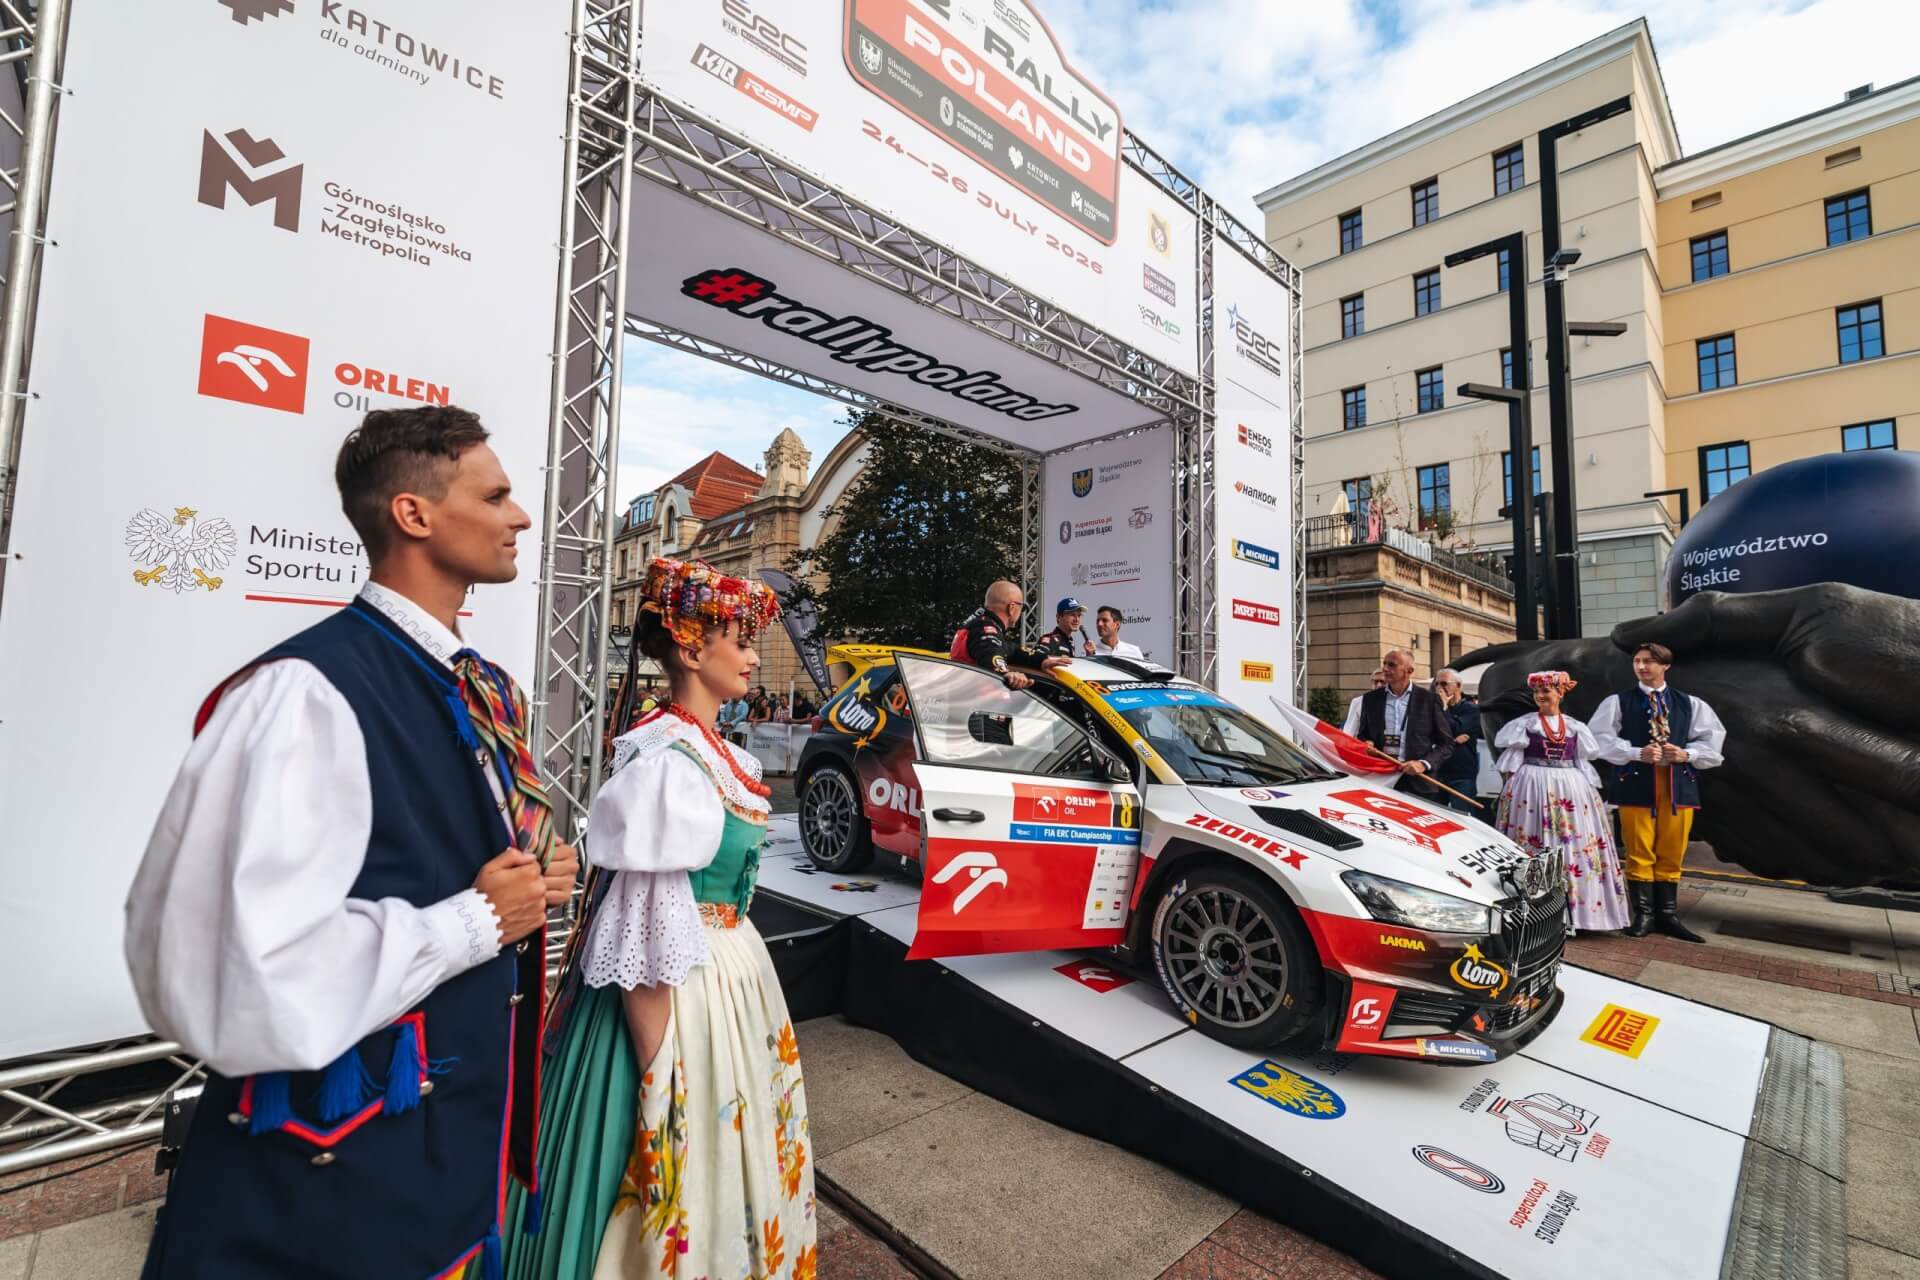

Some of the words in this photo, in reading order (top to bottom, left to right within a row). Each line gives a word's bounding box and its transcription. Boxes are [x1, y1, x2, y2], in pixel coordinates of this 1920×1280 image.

[320, 28, 348, 48] dla
[354, 44, 430, 86] odmiany
[321, 0, 504, 99] KATOWICE
[904, 14, 1091, 173] POLAND
[984, 25, 1112, 142] RALLY
[744, 78, 813, 122] RSMP
[1027, 161, 1060, 189] KATOWICE
[324, 182, 446, 234] Górnośląsko
[321, 219, 431, 266] Metropolia
[976, 191, 1038, 236] JULY
[1046, 233, 1103, 275] 2026
[681, 268, 1079, 421] #rallypoland
[335, 362, 449, 407] ORLEN
[1247, 428, 1273, 449] ENEOS
[1247, 440, 1264, 454] MOTOR
[1264, 447, 1273, 458] OIL
[250, 525, 369, 556] Minister
[1074, 526, 1096, 538] STADION
[1089, 560, 1128, 570] Ministerstwo
[1245, 549, 1276, 564] MICHELIN
[1682, 532, 1828, 568] Województwo
[245, 555, 341, 584] Sportu
[350, 565, 358, 583] i
[1090, 571, 1110, 580] Sportu
[1680, 566, 1741, 591] Śląskie
[1121, 615, 1152, 625] bilistów
[1234, 603, 1256, 618] MRF
[1257, 608, 1279, 622] TYRES
[1244, 663, 1272, 680] PIRELLI
[839, 694, 876, 732] LOTTO
[869, 777, 921, 818] ORL
[1064, 795, 1097, 808] ORLEN
[1064, 807, 1077, 816] OIL
[1120, 792, 1134, 828] 8
[1043, 828, 1056, 838] FIA
[1057, 829, 1070, 839] ERC
[1070, 831, 1113, 842] Championship
[1380, 934, 1426, 953] LAKMA
[1461, 959, 1501, 986] LOTTO
[1592, 1009, 1649, 1052] PIRELLI
[1439, 1044, 1488, 1057] MICHELIN
[1508, 1177, 1551, 1230] superauto.pl
[1533, 1209, 1566, 1245] STADION
